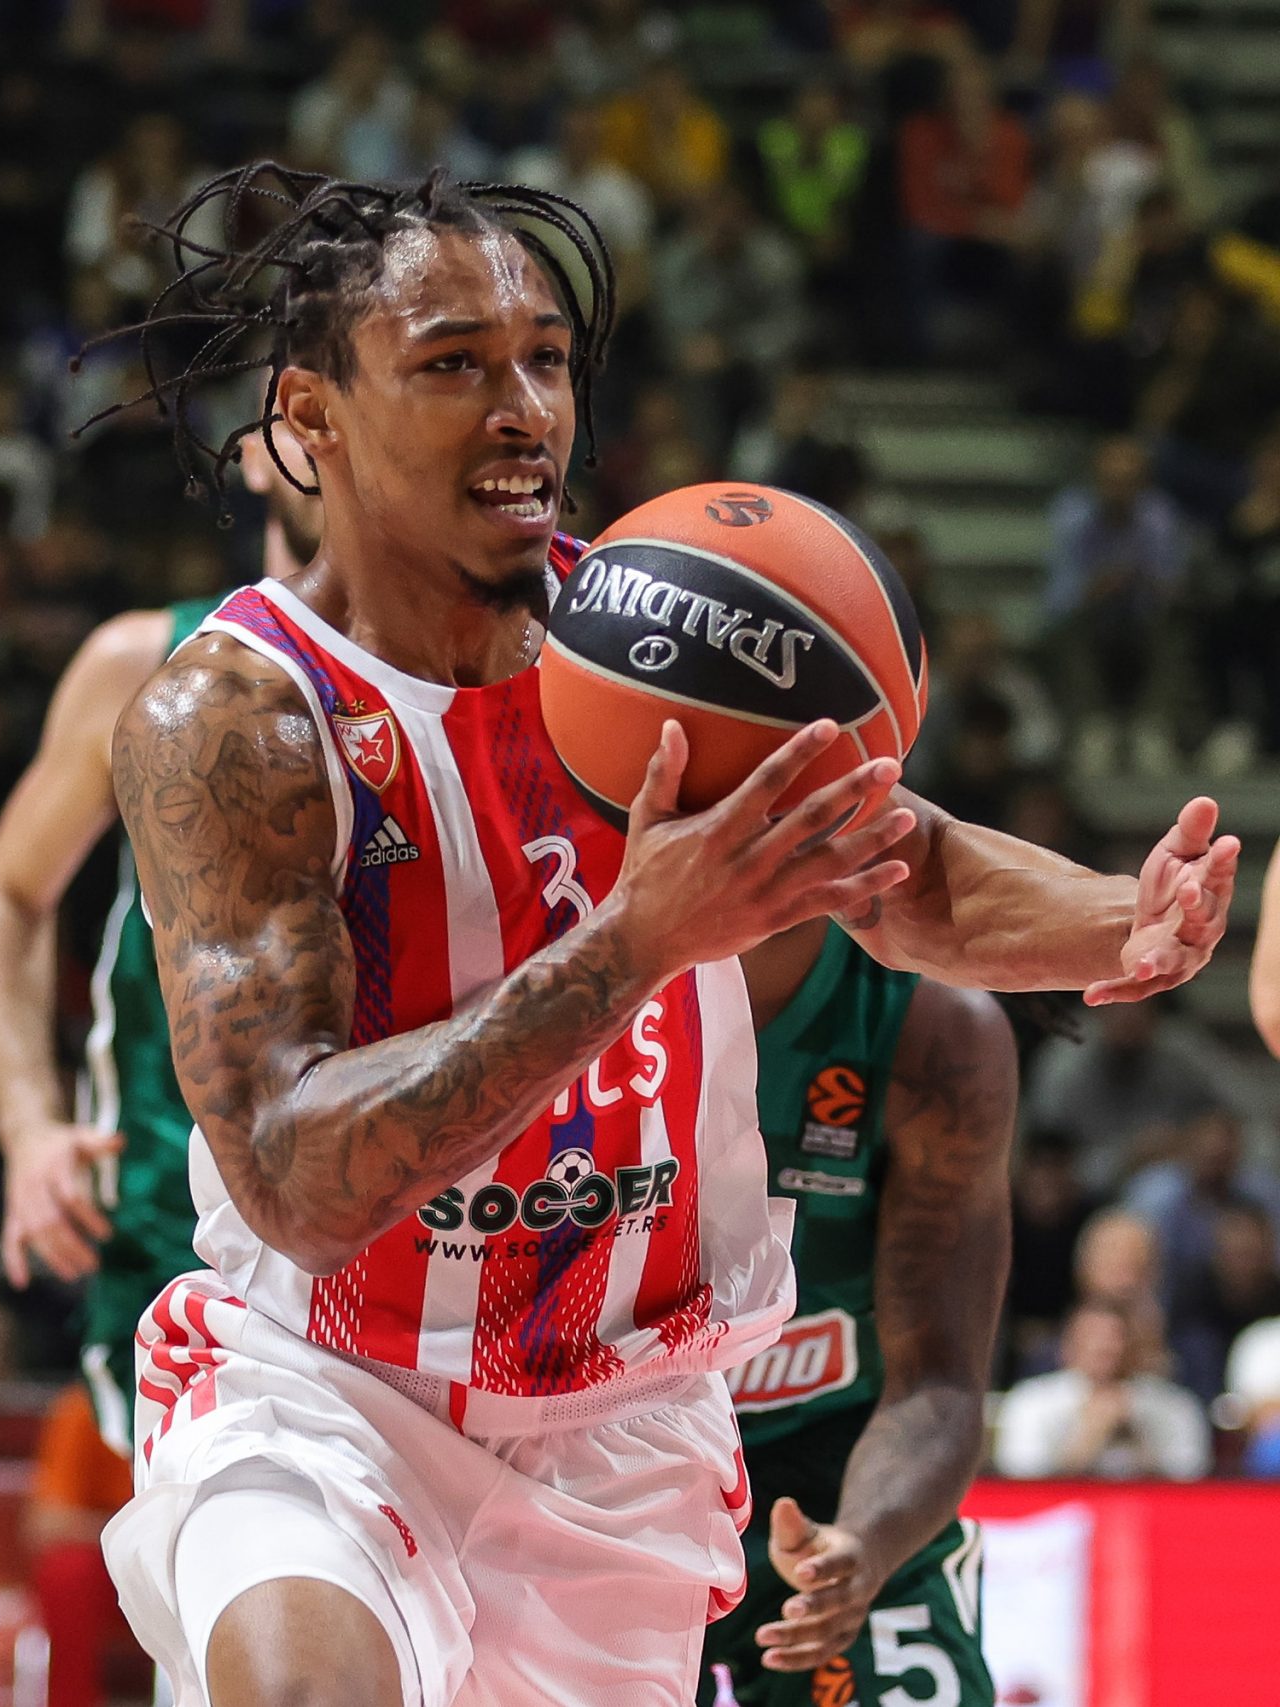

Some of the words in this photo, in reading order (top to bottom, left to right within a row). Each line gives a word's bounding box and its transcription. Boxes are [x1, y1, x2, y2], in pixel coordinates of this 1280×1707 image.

[567, 558, 816, 689] SPALDING
[360, 845, 419, 867] adidas
[418, 1157, 680, 1234] SOCCER
[868, 1603, 962, 1707] 5
